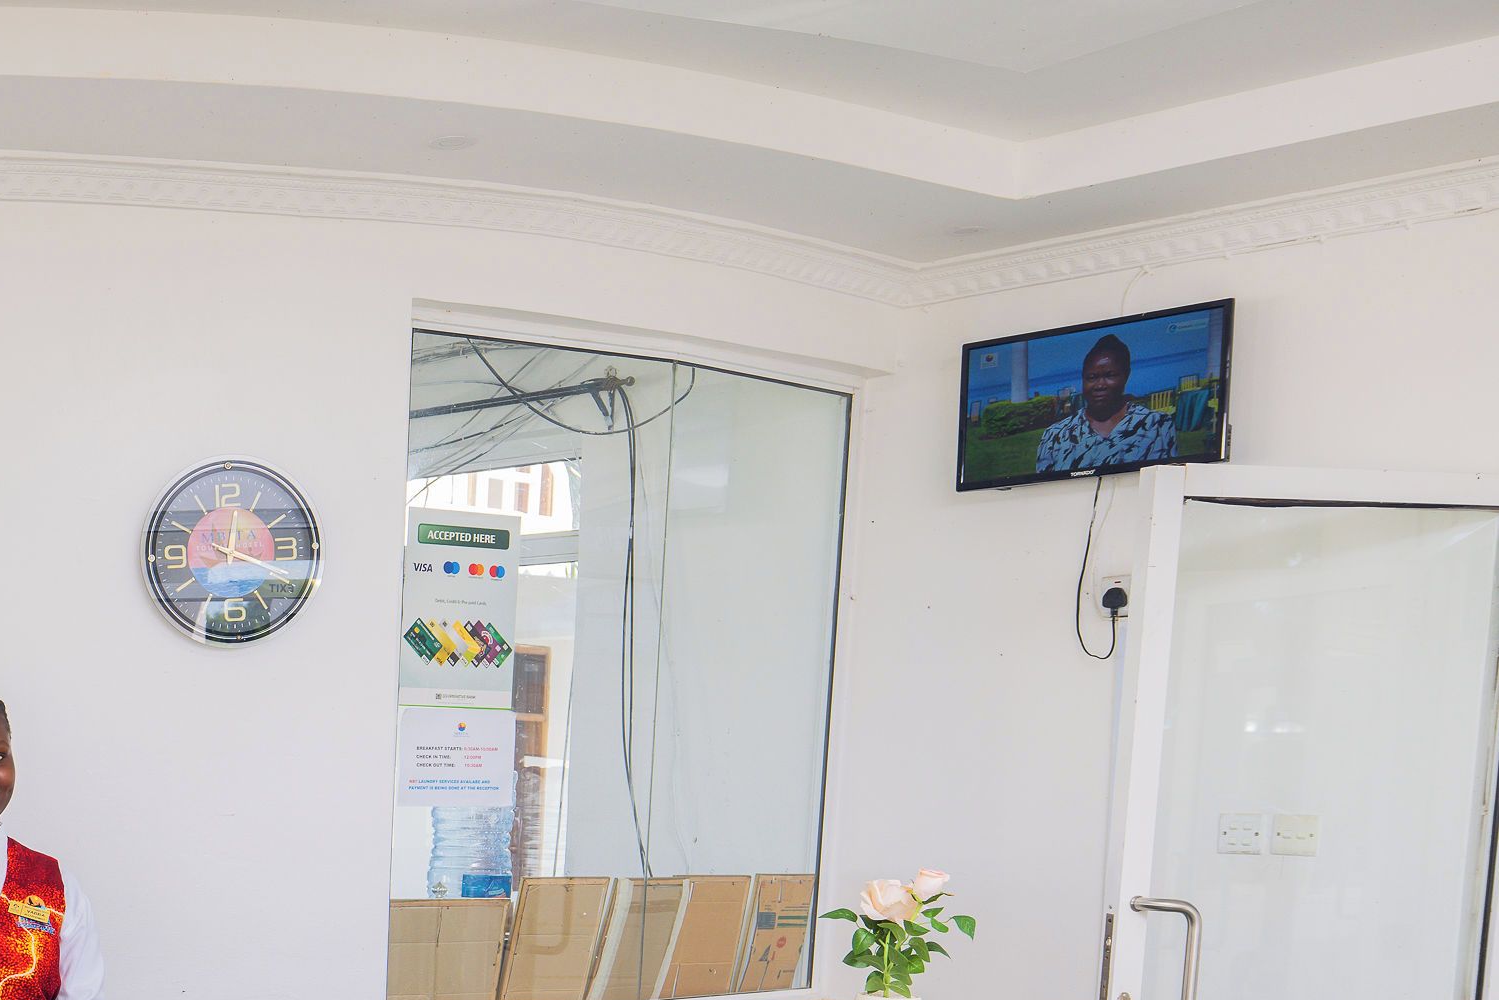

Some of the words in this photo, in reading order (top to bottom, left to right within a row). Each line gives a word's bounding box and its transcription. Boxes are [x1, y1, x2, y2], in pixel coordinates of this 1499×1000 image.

[215, 483, 241, 507] 12
[274, 536, 297, 561] 3
[427, 529, 472, 544] ACCEPTED
[473, 534, 496, 544] HERE
[164, 544, 187, 569] 9
[413, 562, 433, 573] VISA
[224, 597, 247, 622] 6
